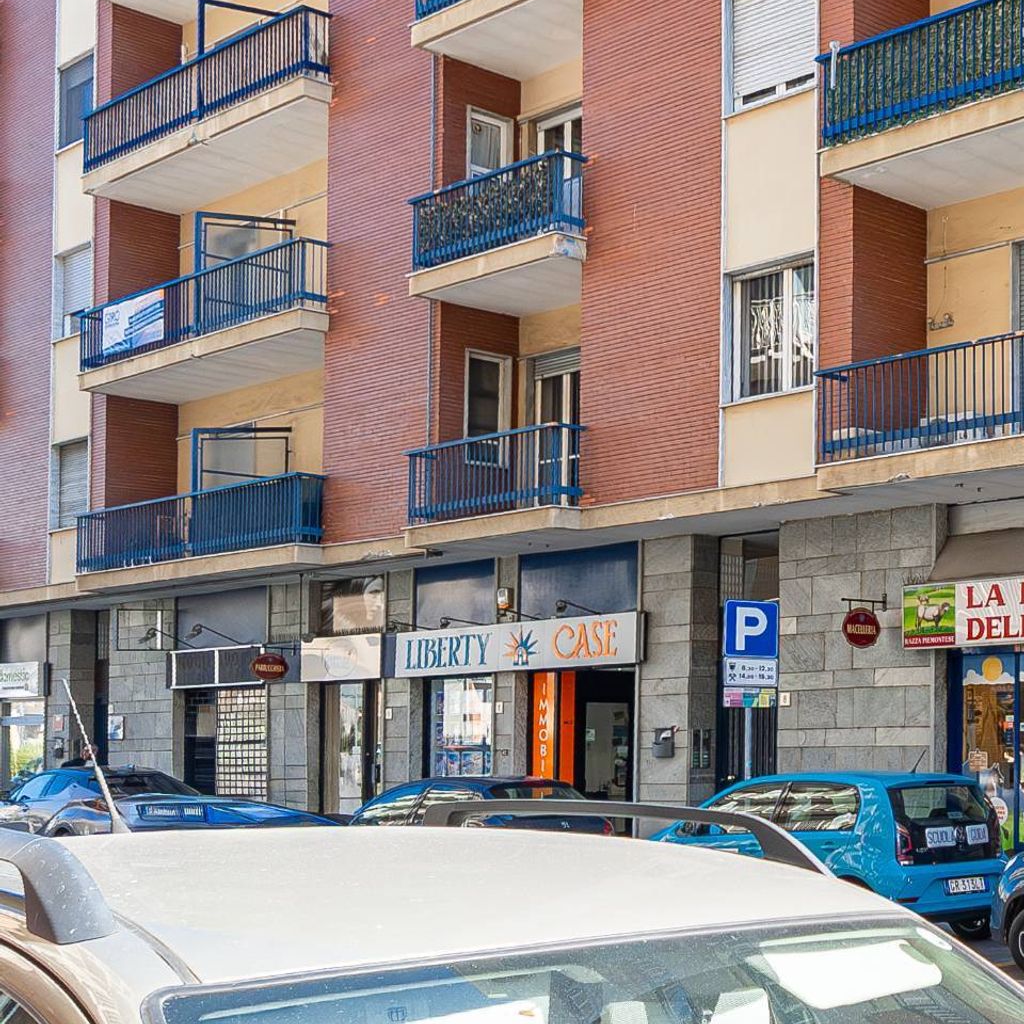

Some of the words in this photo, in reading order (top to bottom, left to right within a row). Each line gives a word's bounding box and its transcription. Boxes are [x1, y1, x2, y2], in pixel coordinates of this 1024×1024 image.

[966, 583, 1006, 609] LA
[735, 606, 768, 651] P
[846, 623, 876, 635] MACELLERIA
[904, 637, 922, 646] RAZZA
[922, 635, 955, 644] PIEMONTESE
[404, 632, 493, 670] LIBERTY
[552, 619, 619, 660] CASE
